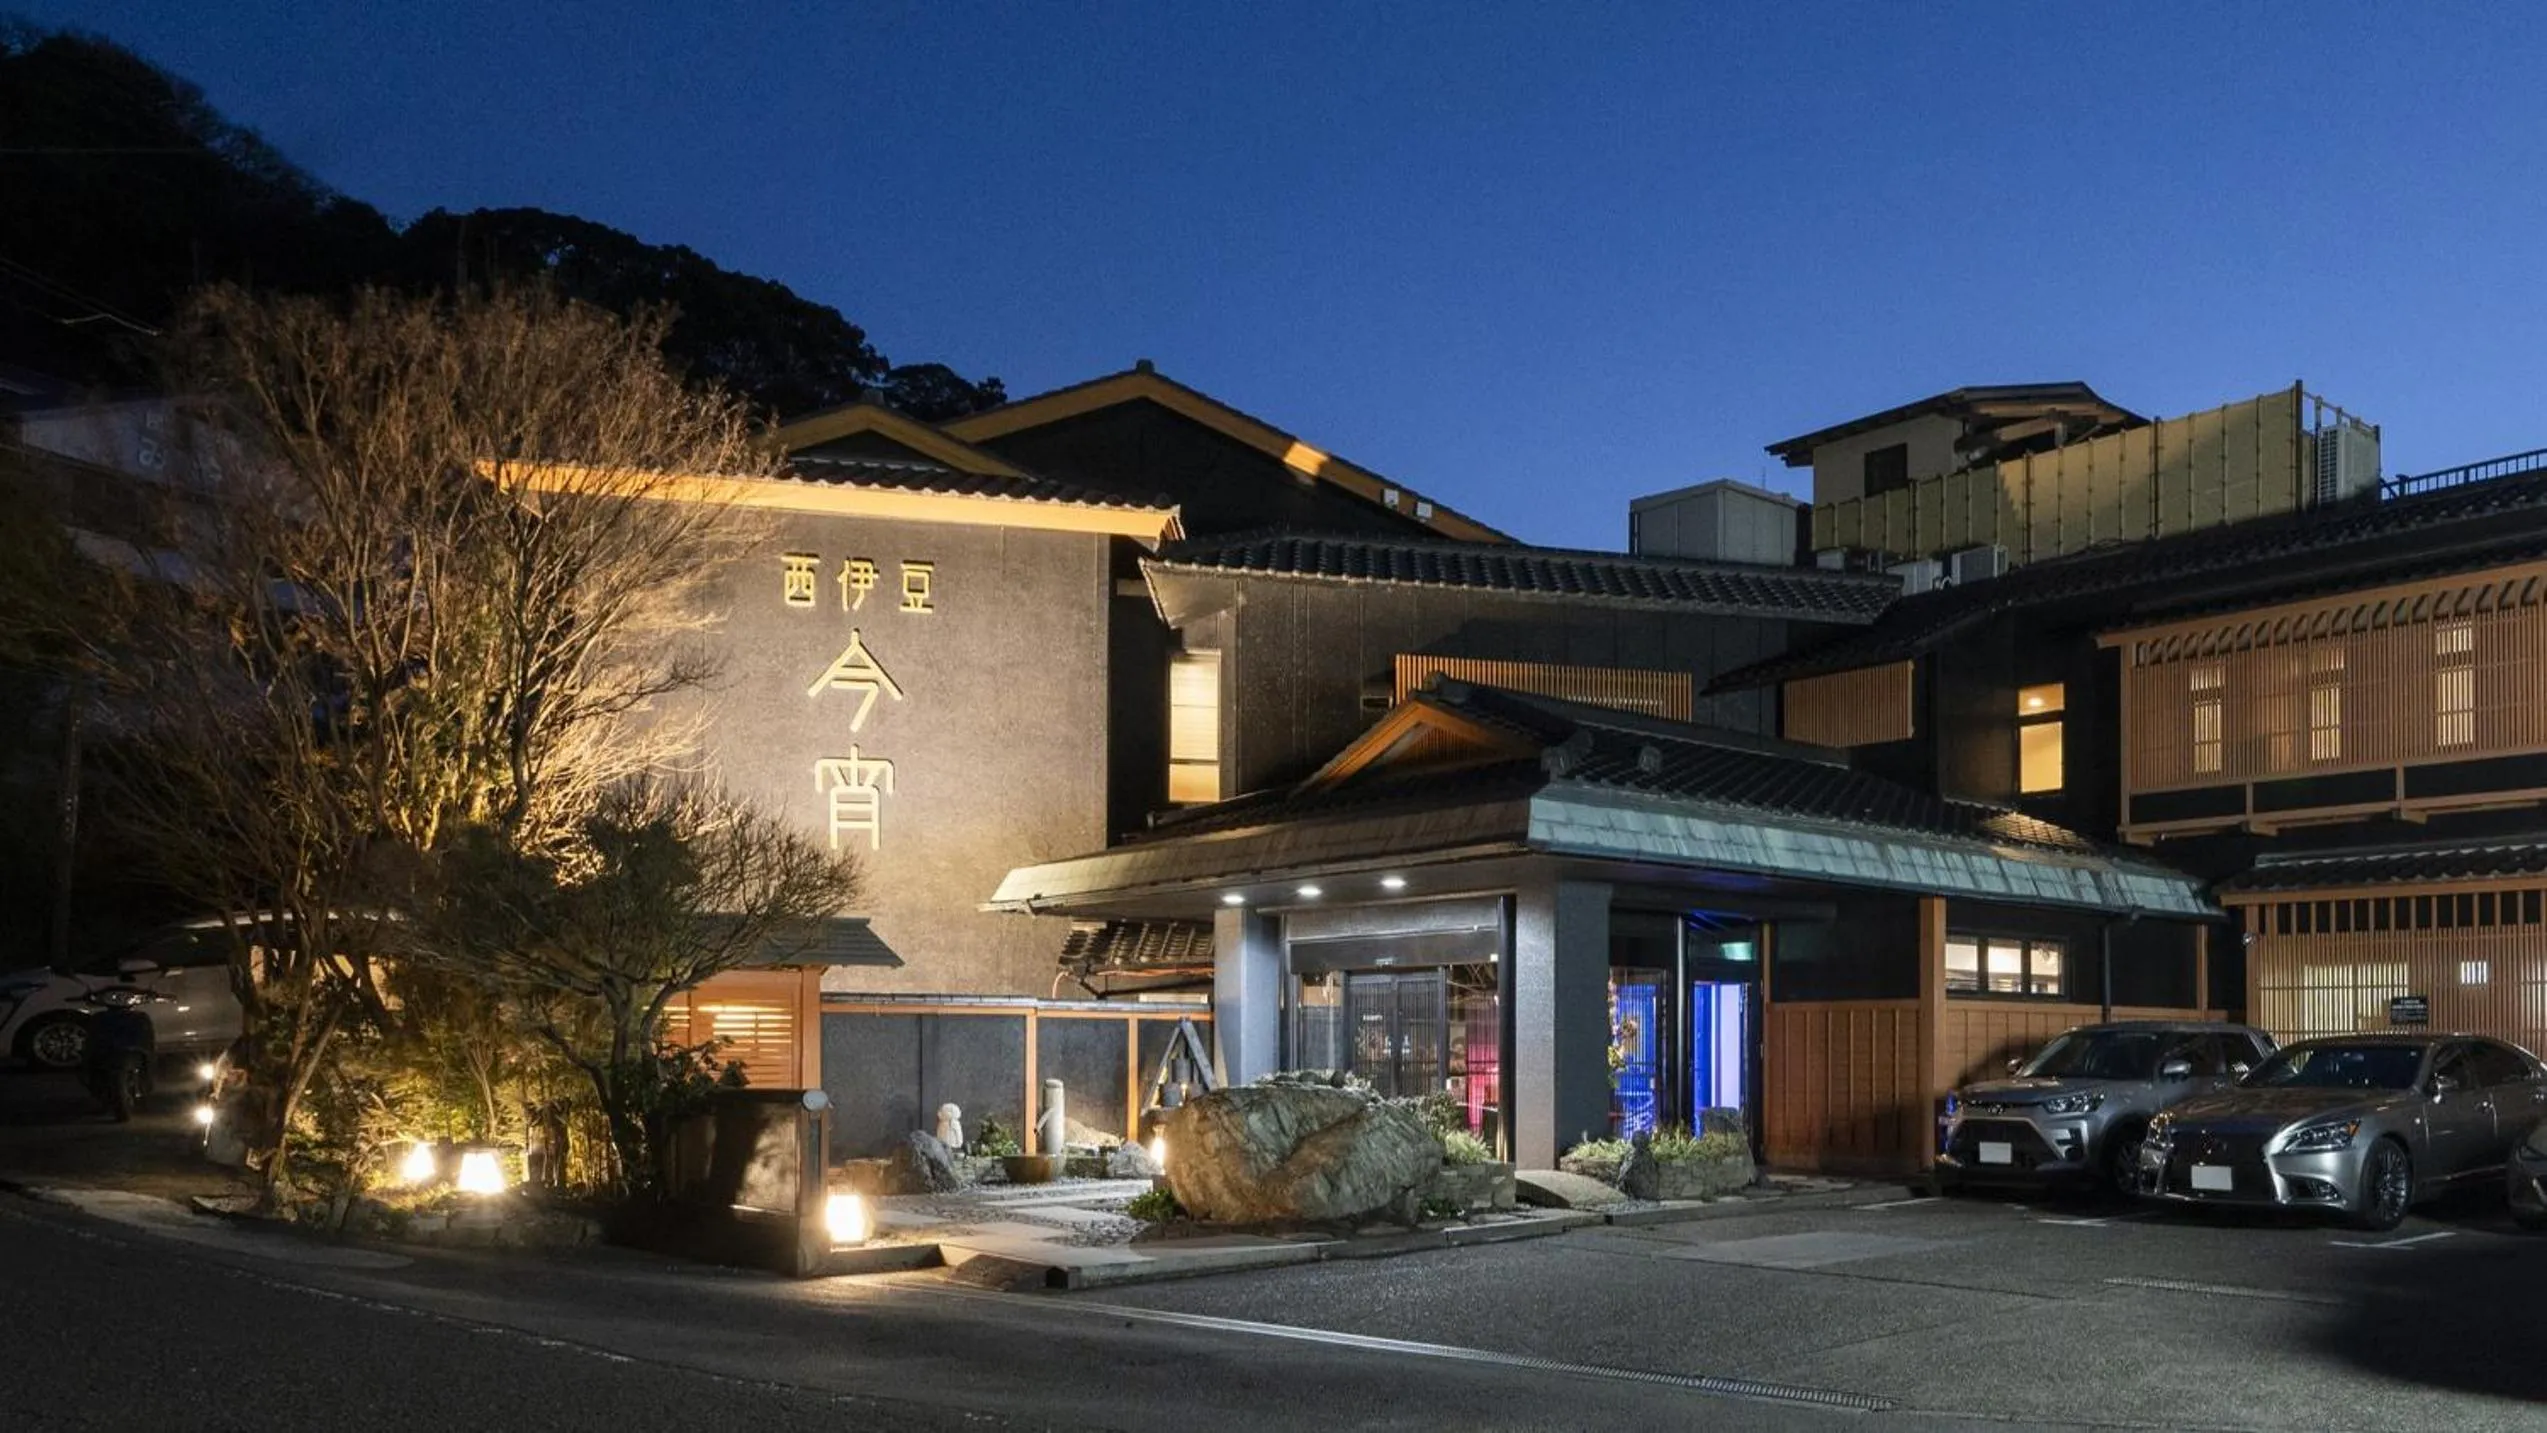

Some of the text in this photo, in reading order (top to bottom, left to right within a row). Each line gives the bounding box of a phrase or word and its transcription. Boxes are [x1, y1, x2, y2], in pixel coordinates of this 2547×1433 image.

[780, 554, 935, 614] 西伊豆
[807, 629, 904, 851] 今宵
